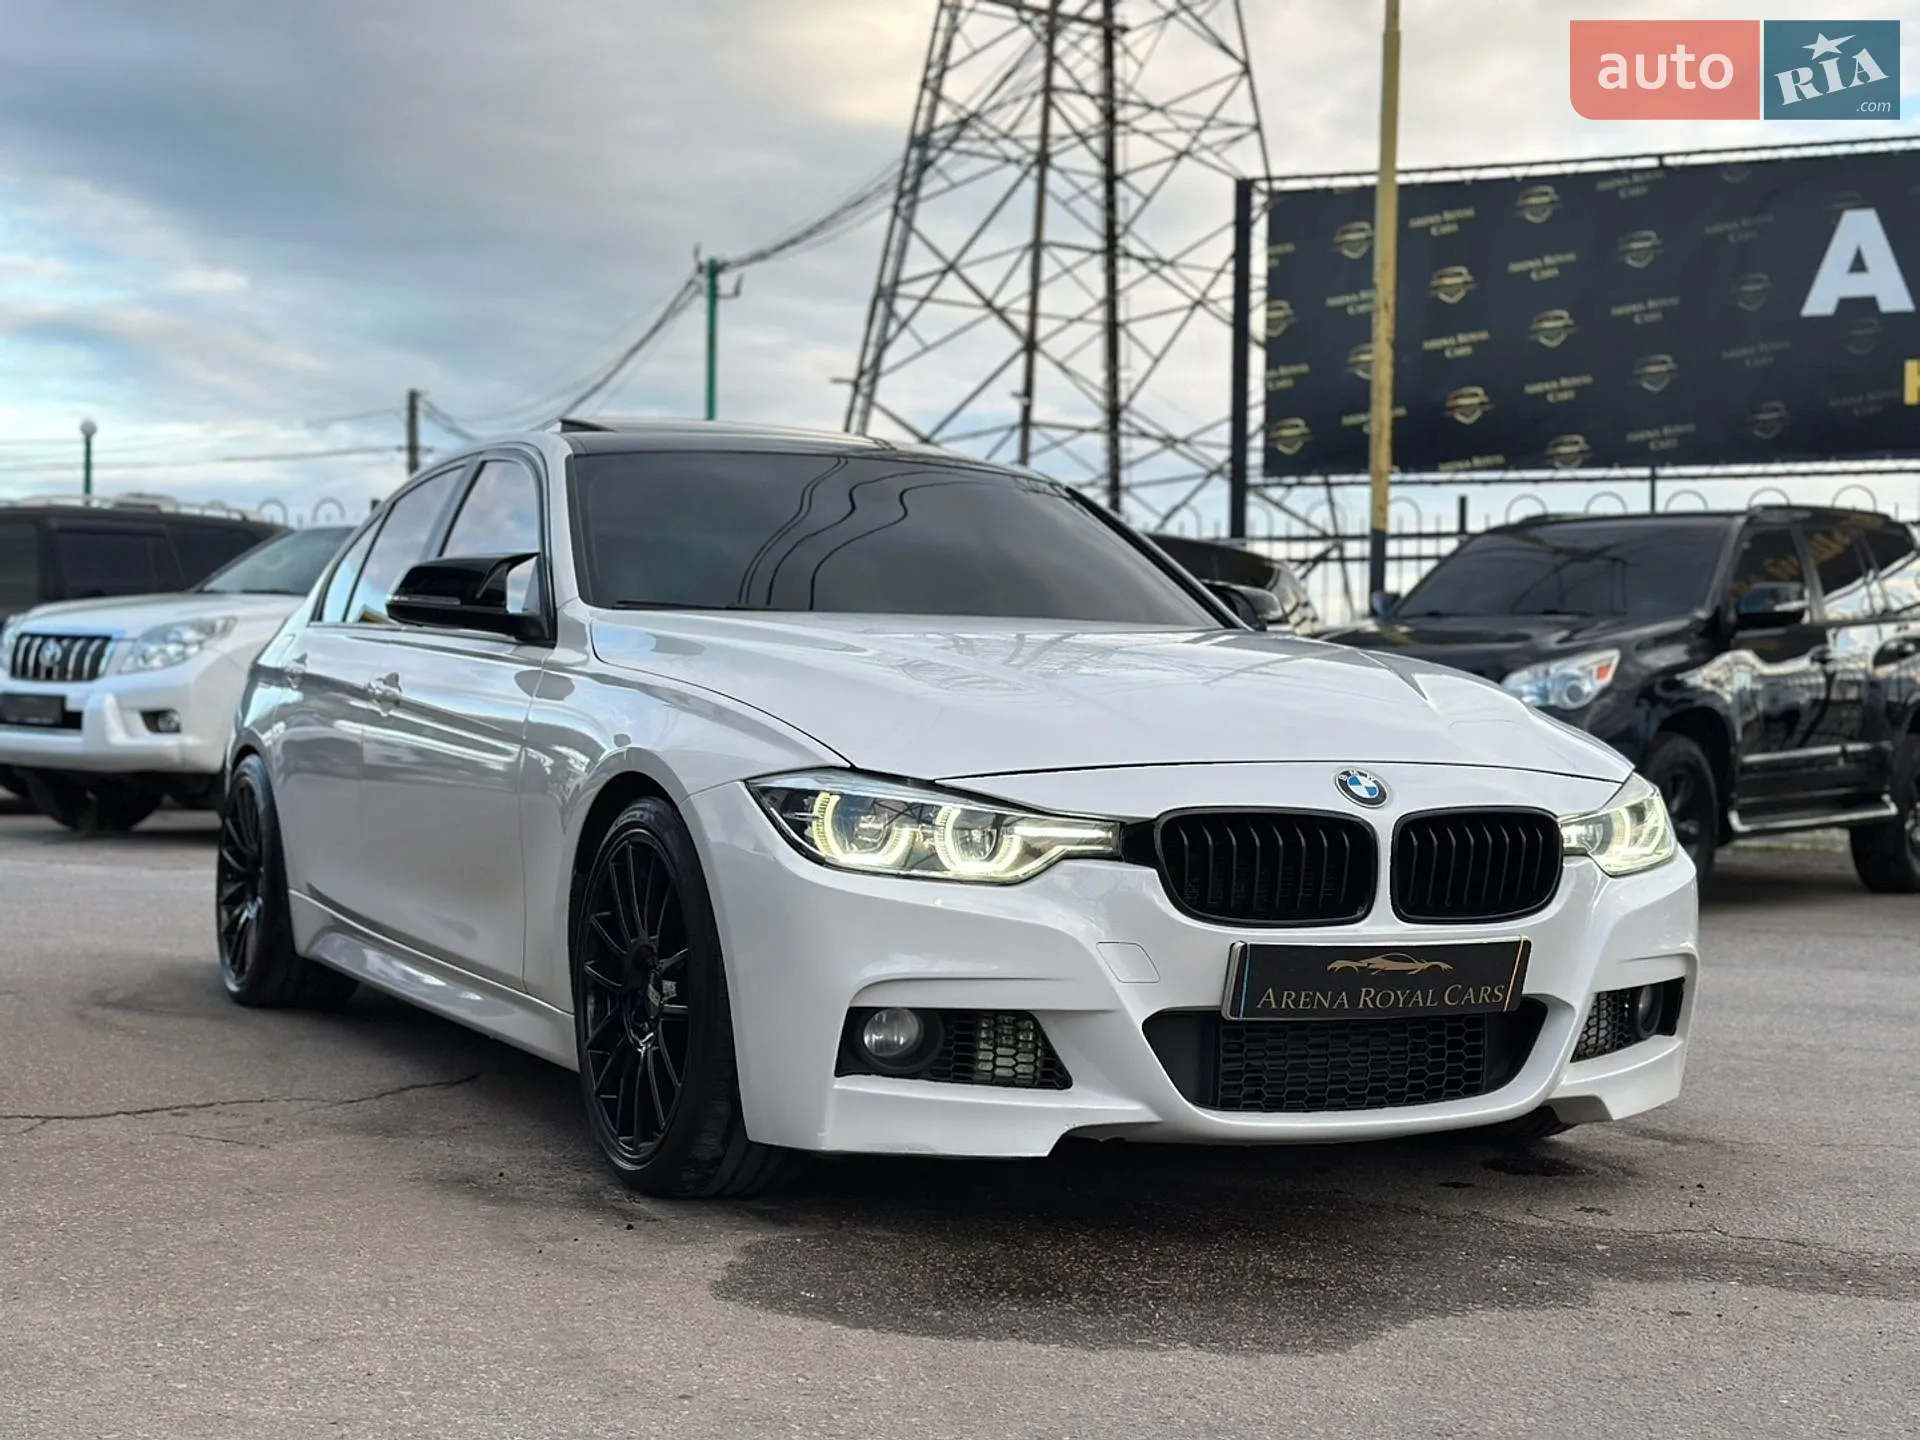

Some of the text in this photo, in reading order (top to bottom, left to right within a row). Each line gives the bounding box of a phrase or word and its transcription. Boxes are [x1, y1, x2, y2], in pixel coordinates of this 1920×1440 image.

[1800, 207, 1916, 317] A
[1338, 768, 1376, 782] BMW
[1256, 983, 1506, 1010] ARENA ROYAL CARS
